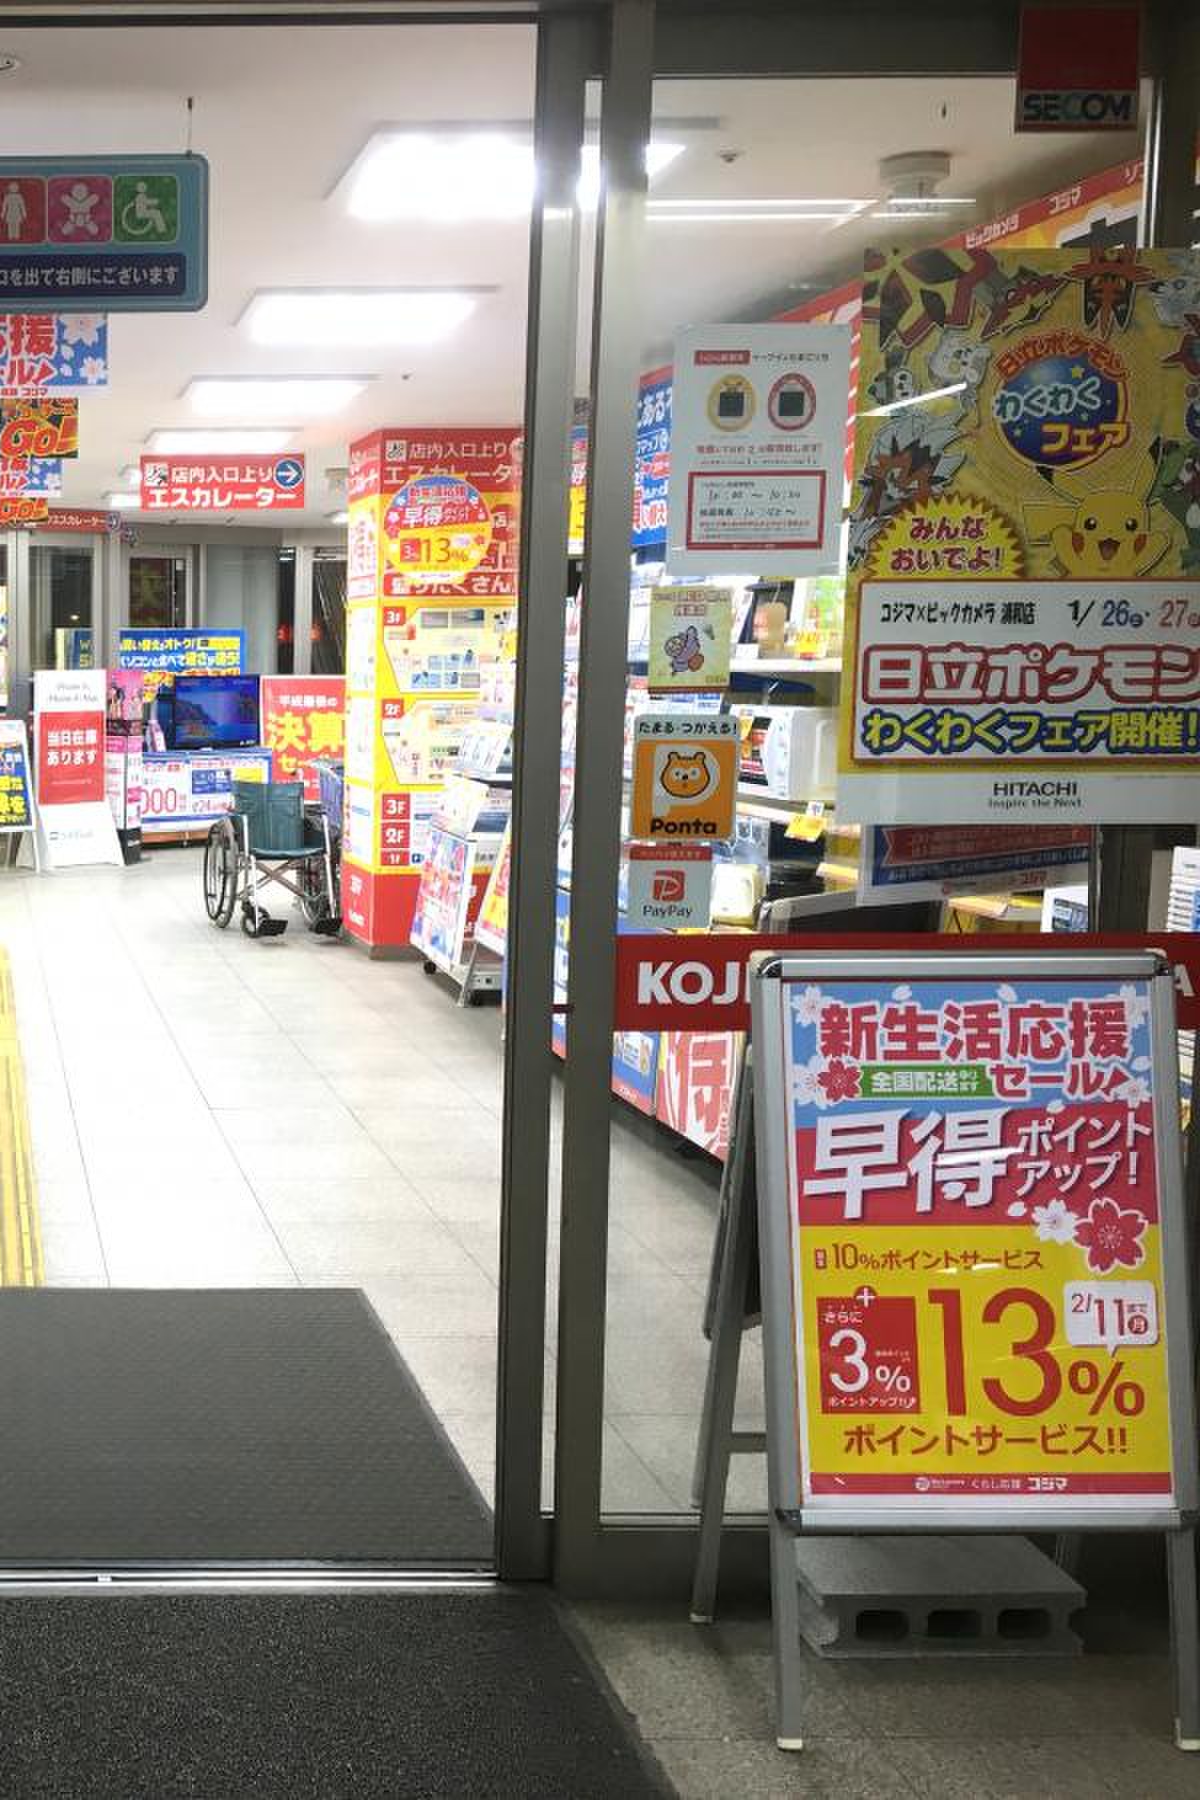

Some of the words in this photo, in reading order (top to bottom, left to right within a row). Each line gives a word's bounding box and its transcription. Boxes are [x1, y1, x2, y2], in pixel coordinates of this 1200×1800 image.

[1023, 93, 1131, 122] SECOM
[1041, 422, 1130, 454] フェア
[172, 464, 272, 485] 店内入口上り
[147, 486, 297, 508] エスカレーター
[910, 515, 988, 540] みんな
[890, 547, 1002, 572] おいでよ!
[868, 645, 1200, 704] 日立ポケモン
[266, 711, 344, 751] 決算
[864, 708, 1200, 754] わくわくフェア開催!
[47, 749, 97, 766] あります
[993, 781, 1078, 797] HITACHI
[650, 818, 717, 835] Ponta
[643, 904, 693, 919] PayPay
[817, 1000, 1132, 1062] 新生活応援
[1017, 1109, 1153, 1155] ポイント
[804, 1107, 1012, 1219] 早得
[1016, 1150, 1140, 1198] アップ!
[824, 1310, 864, 1324] さらに
[844, 1424, 1127, 1457] ポイントサービス!!
[1027, 1476, 1068, 1491] コジマ
